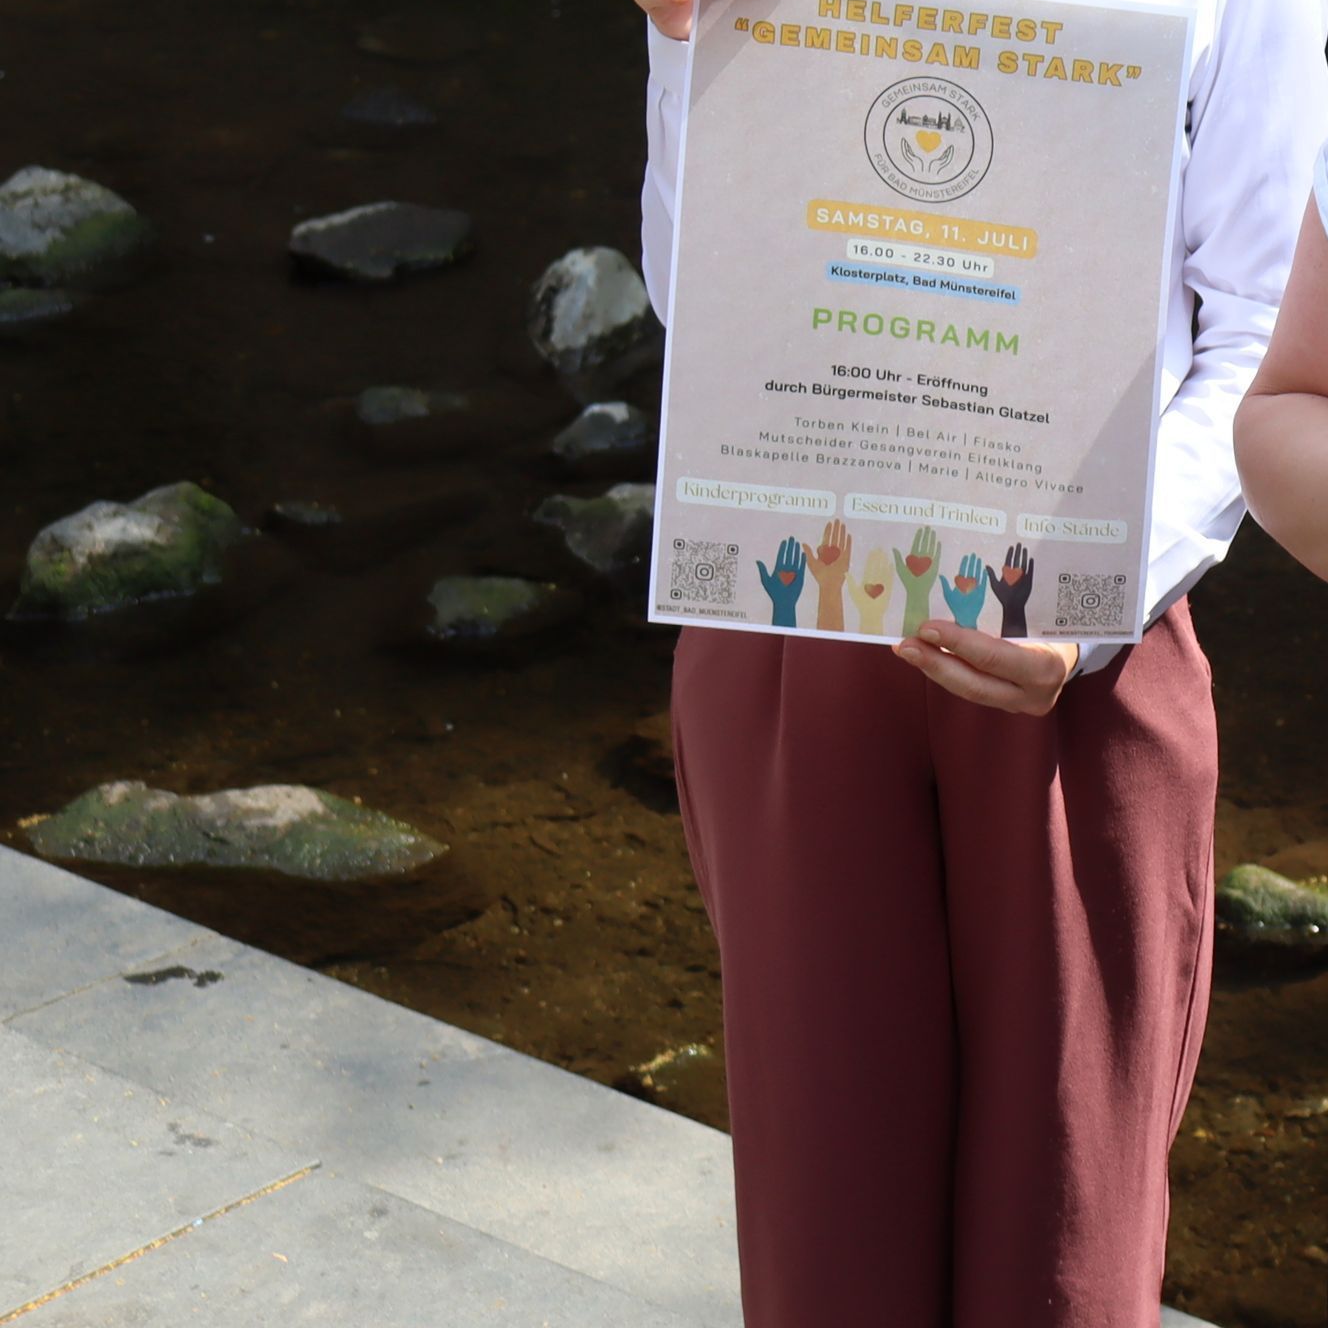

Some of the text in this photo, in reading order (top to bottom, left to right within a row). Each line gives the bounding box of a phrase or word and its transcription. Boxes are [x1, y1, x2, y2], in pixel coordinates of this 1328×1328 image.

[734, 16, 1142, 88] “GEMEINSAM STARK”
[882, 82, 981, 121] GEMEINSAM STARK
[874, 154, 980, 198] FÜR BAD MÜNSTEREIFEL
[816, 205, 1027, 251] SAMSTAG, 11. JULI
[853, 244, 894, 258] 16.00
[913, 252, 955, 267] 22.30
[961, 259, 988, 272] Uhr
[830, 265, 1015, 300] Klosterplatz, Bad Münstereifel
[812, 305, 1019, 355] PROGRAMM
[831, 364, 871, 379] 16:00
[875, 368, 902, 382] Uhr
[916, 373, 988, 397] Eröffnung
[764, 379, 1049, 424] durch Bürgermeister Sebastian Glatzel
[758, 430, 1042, 474] Mutscheider Gesangverein Eifelklang
[794, 416, 1021, 453] Torben Klein Bel Air Fiasko
[720, 444, 1084, 494] Blaskapelle Brazzanova Marie Allegro Vivace
[683, 481, 828, 509] Kinderprogramm
[851, 497, 999, 527] Essen und Trinken
[1024, 518, 1121, 538] Info Stände
